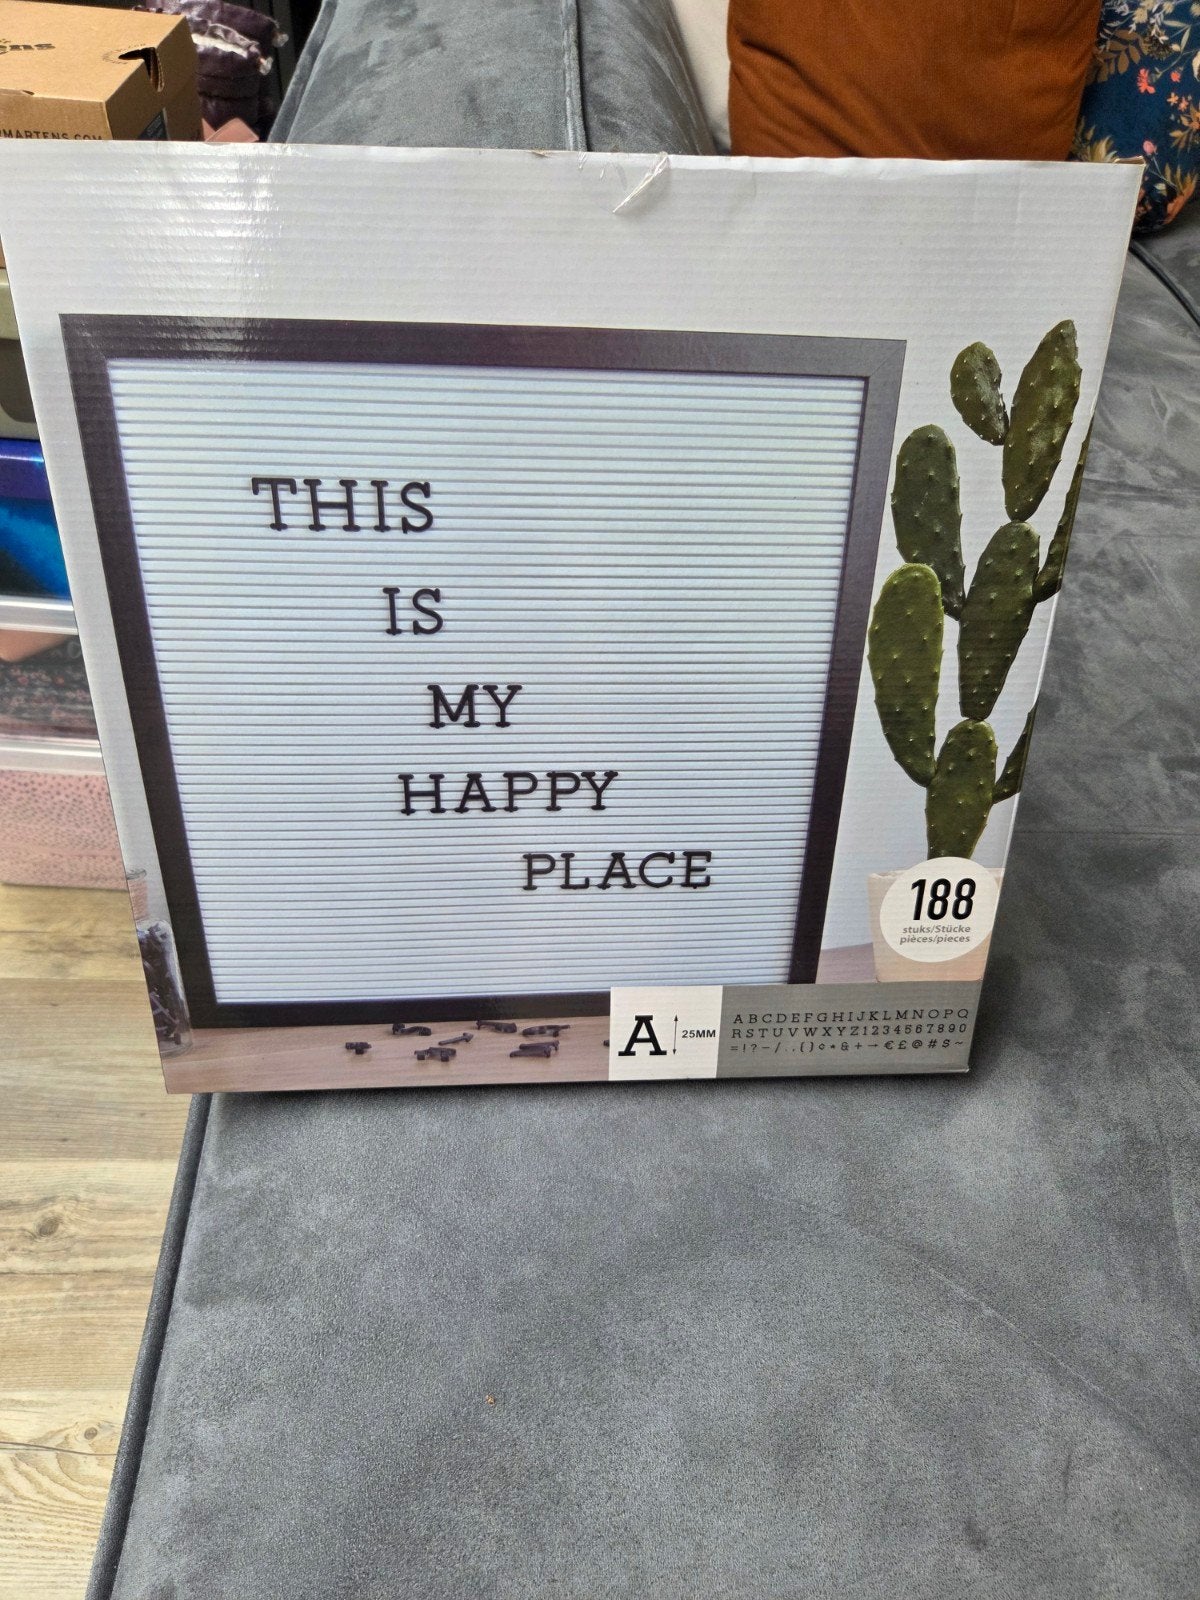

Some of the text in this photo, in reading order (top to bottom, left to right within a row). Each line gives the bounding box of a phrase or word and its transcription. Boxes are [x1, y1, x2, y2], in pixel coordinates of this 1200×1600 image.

[251, 477, 434, 534] THIS
[382, 587, 444, 636] IS
[427, 684, 523, 729] MY
[397, 771, 619, 816] HAPPY
[522, 850, 712, 891] PLACE
[910, 878, 977, 921] 188
[617, 1015, 667, 1057] A
[681, 1028, 717, 1039] 25MM
